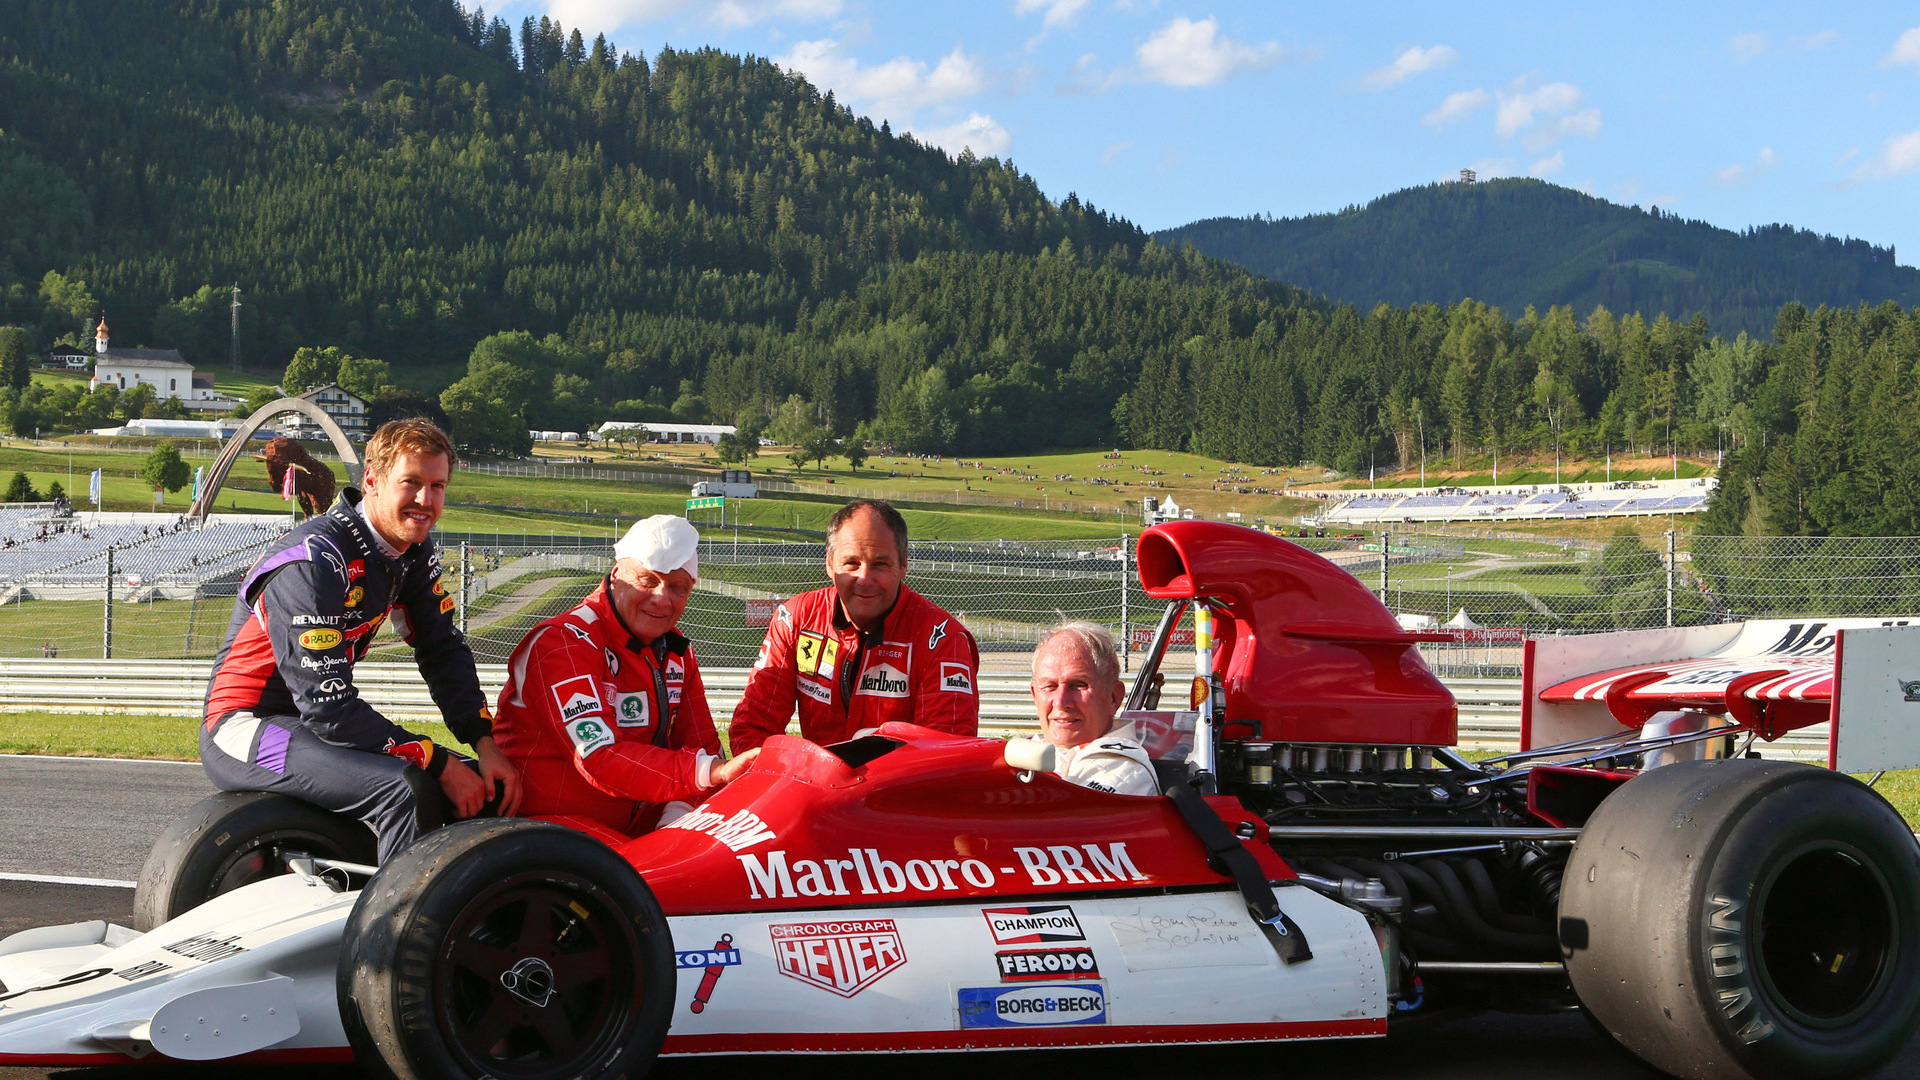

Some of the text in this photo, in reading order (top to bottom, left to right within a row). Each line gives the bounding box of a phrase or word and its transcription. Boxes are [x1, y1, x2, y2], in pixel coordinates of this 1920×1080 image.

[292, 615, 341, 626] RENAULT
[310, 633, 339, 645] RAUCH
[1135, 631, 1150, 642] Fly
[300, 655, 349, 672] Pepe Jeans
[860, 670, 907, 693] Marlboro
[563, 699, 600, 721] Marlboro
[736, 847, 996, 901] Marlboro
[1012, 842, 1149, 887] BRM
[771, 921, 895, 937] CHRONOGRAPH
[994, 916, 1075, 932] CHAMPION
[676, 951, 738, 967] KONI
[778, 934, 901, 989] HEUER
[1000, 952, 1095, 974] FERODO
[1708, 893, 1776, 1046] AVON
[997, 995, 1102, 1015] BORG&BECK
